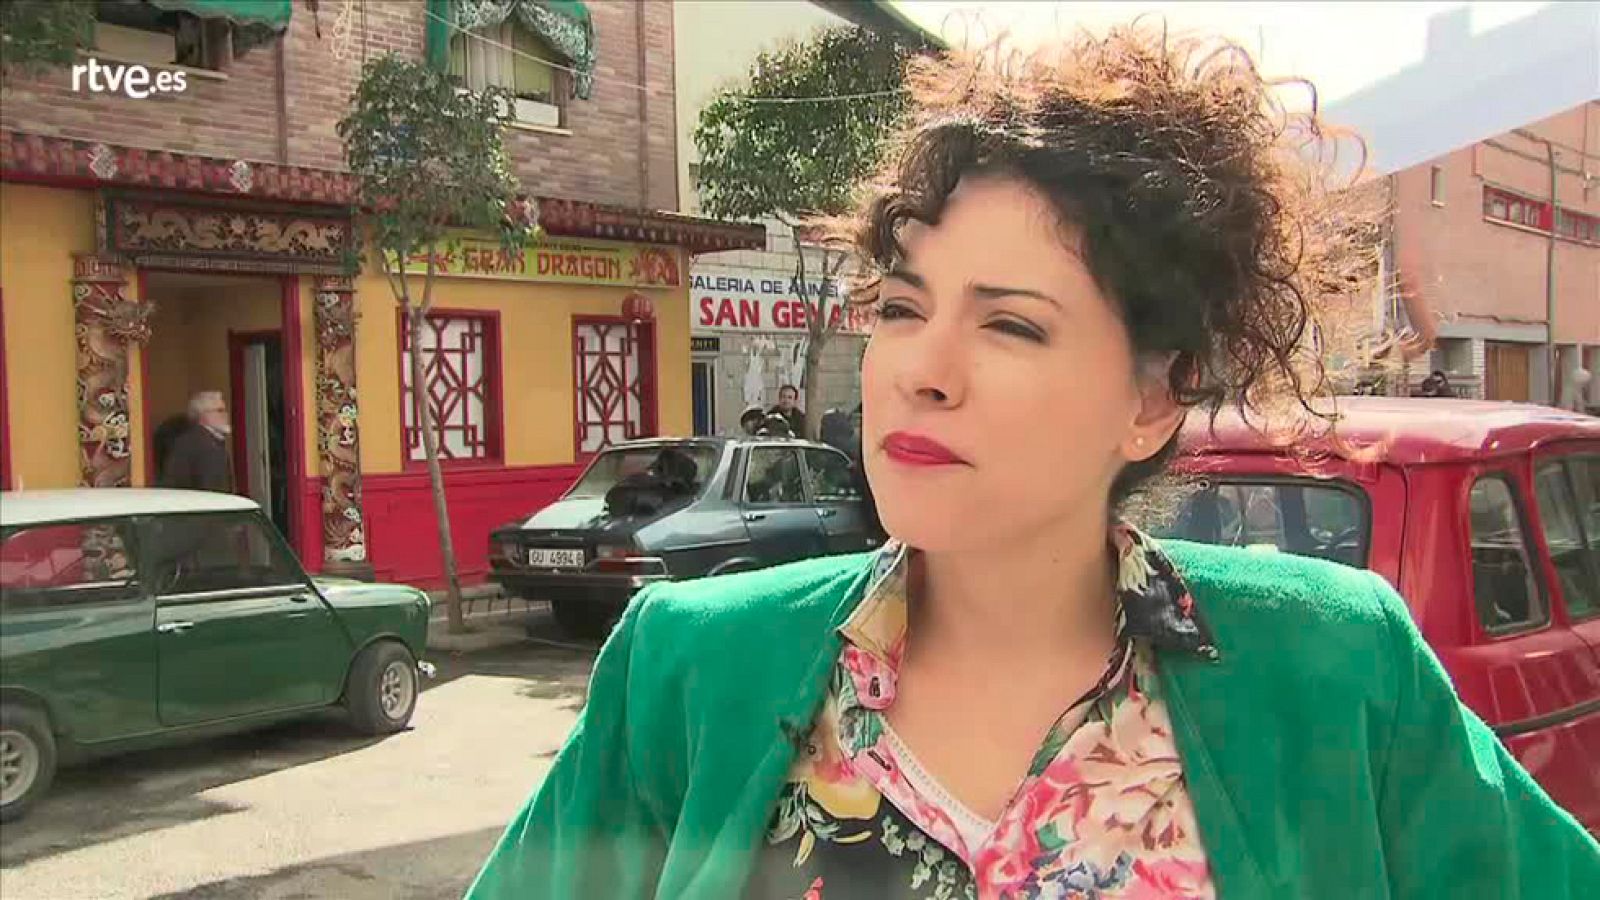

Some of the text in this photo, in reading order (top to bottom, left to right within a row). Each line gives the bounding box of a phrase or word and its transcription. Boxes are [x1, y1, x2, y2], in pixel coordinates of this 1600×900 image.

[464, 248, 620, 280] GRAN DRAGON
[760, 279, 783, 294] DE
[699, 297, 760, 327] SAN
